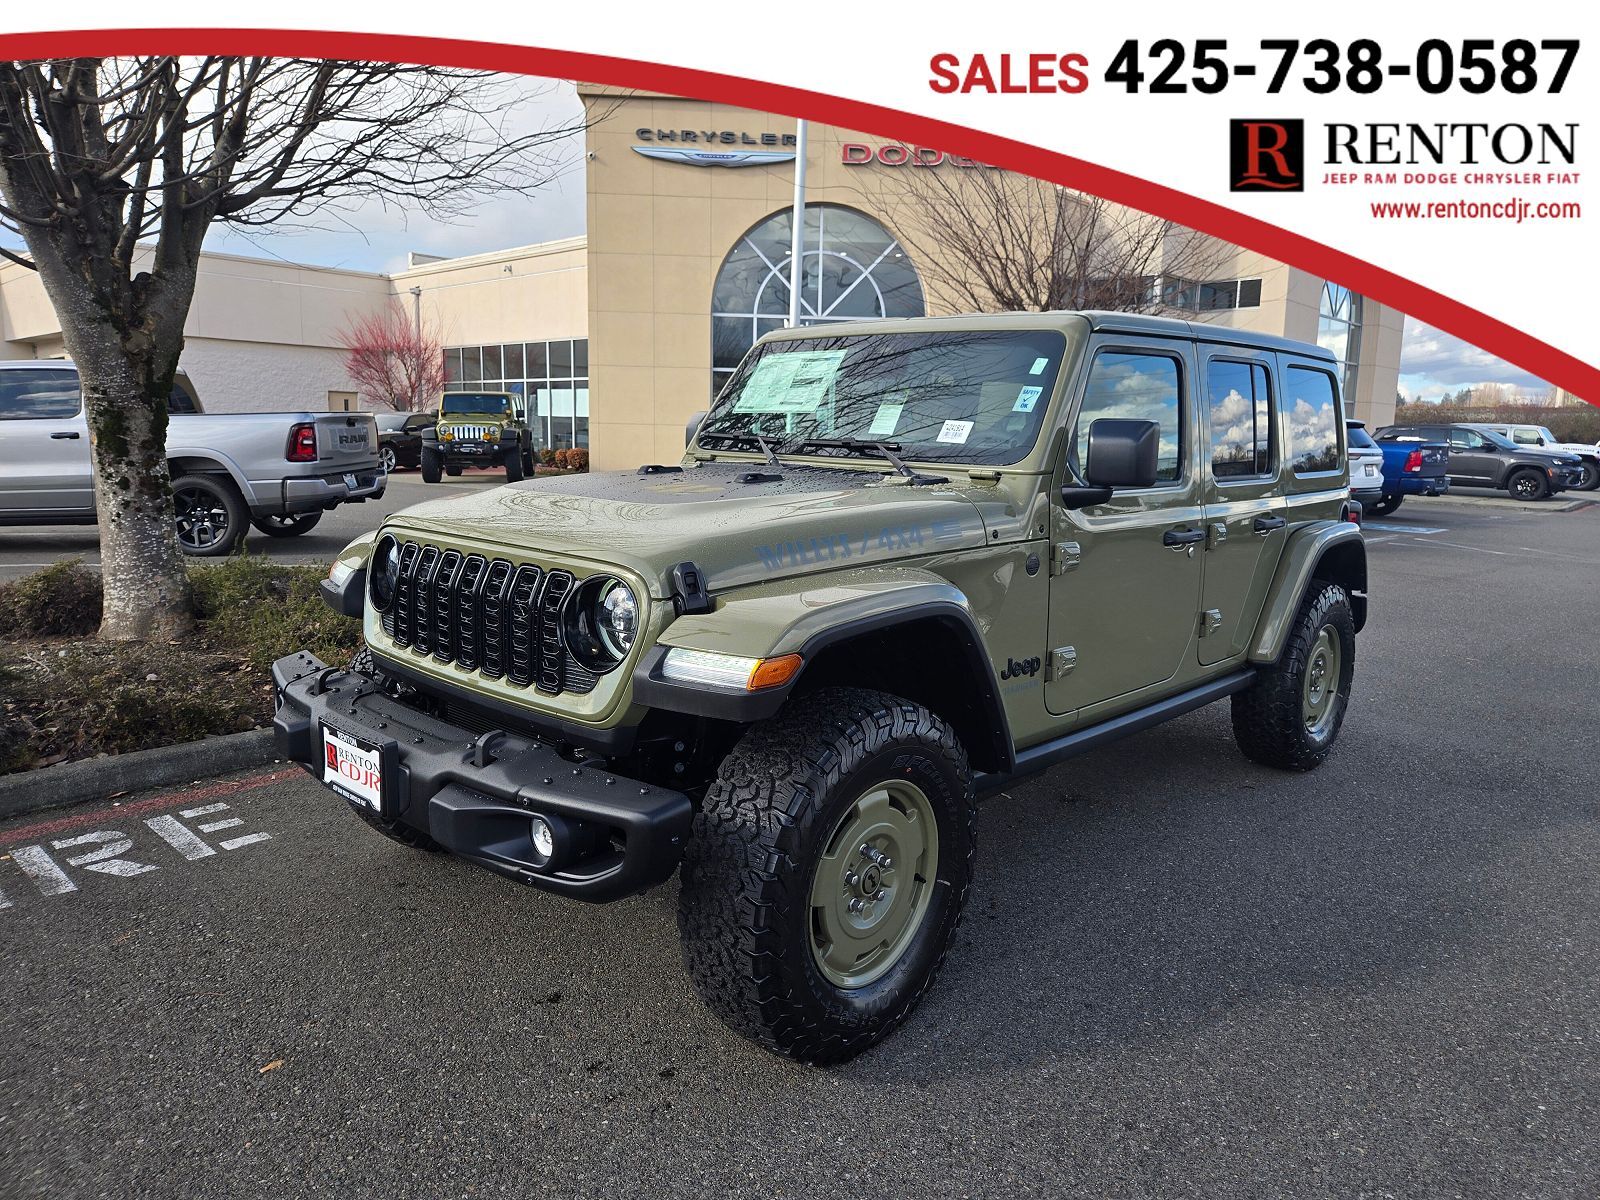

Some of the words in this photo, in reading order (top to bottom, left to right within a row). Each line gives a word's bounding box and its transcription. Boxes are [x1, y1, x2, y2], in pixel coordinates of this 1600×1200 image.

[635, 128, 797, 146] CHRYSLER
[842, 143, 1001, 168] DOD
[339, 434, 367, 445] RAM
[755, 533, 851, 571] WILLYS
[1001, 656, 1040, 680] Jeep
[339, 747, 380, 774] RENTON
[339, 759, 381, 792] CDJR
[0, 802, 273, 909] RE
